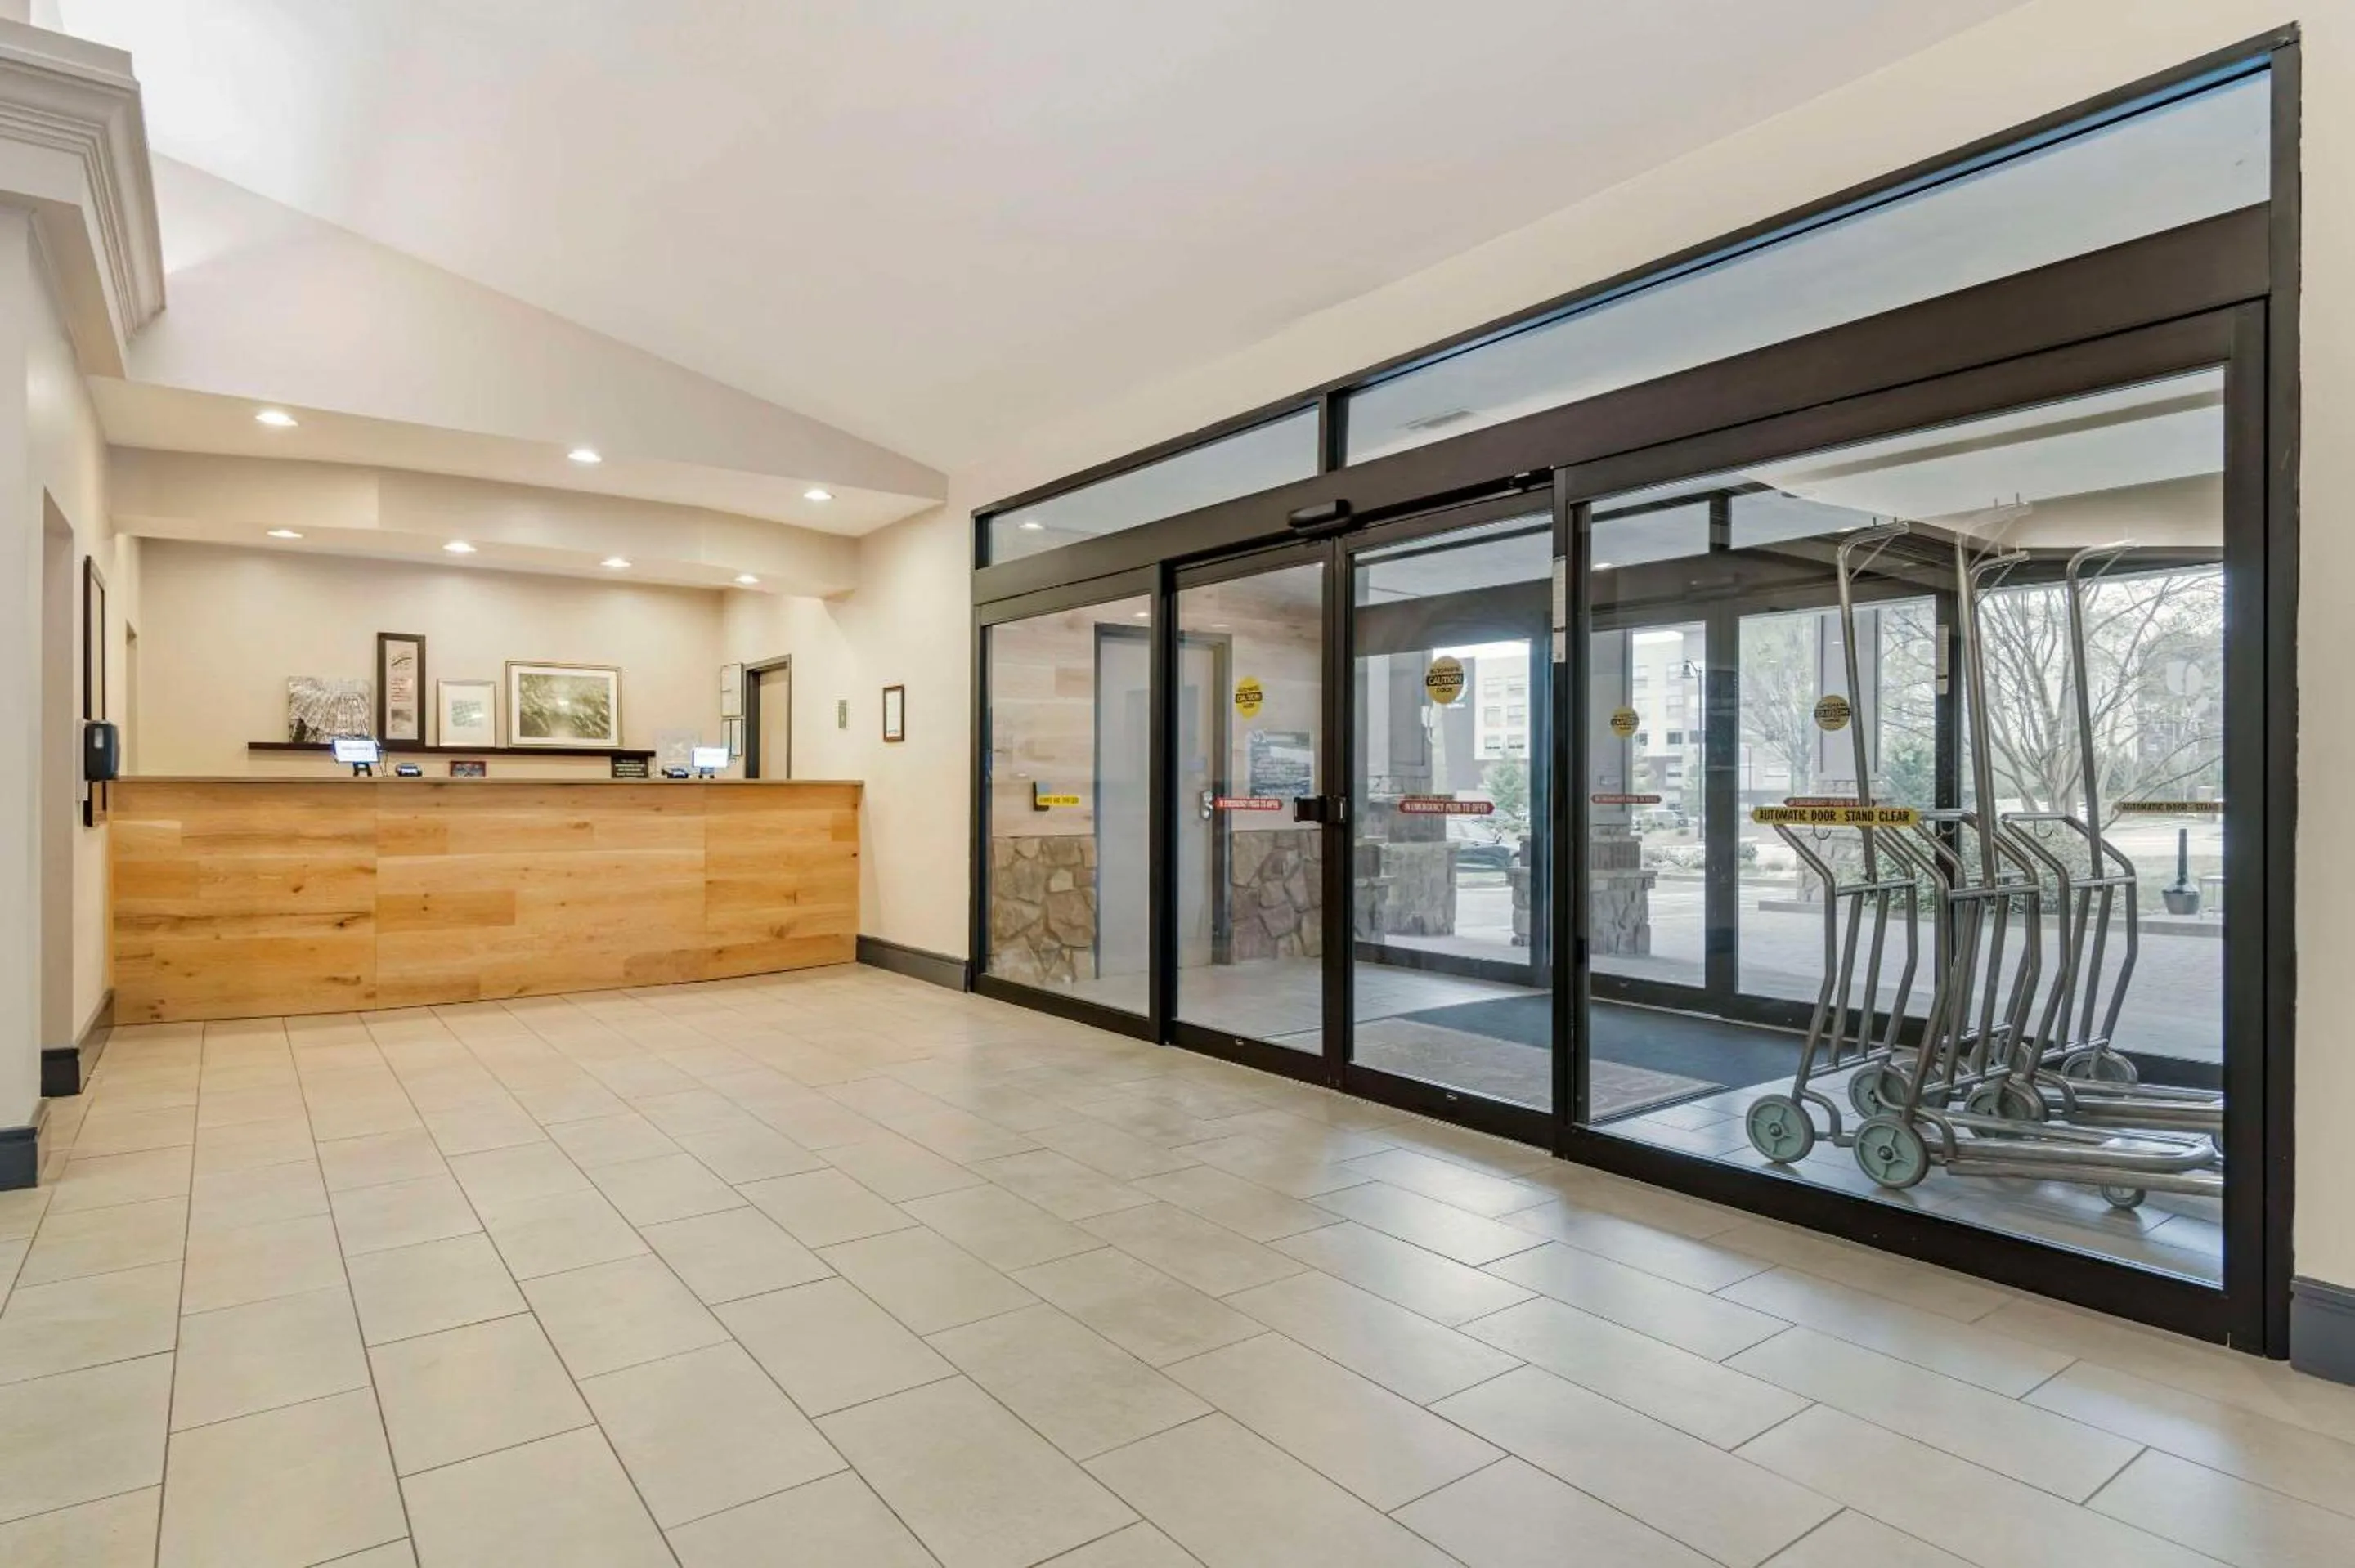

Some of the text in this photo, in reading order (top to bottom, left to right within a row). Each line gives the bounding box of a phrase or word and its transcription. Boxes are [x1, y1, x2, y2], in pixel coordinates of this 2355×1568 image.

[1759, 809, 1909, 822] AUTOMATIC DOOR STAND CLEAR
